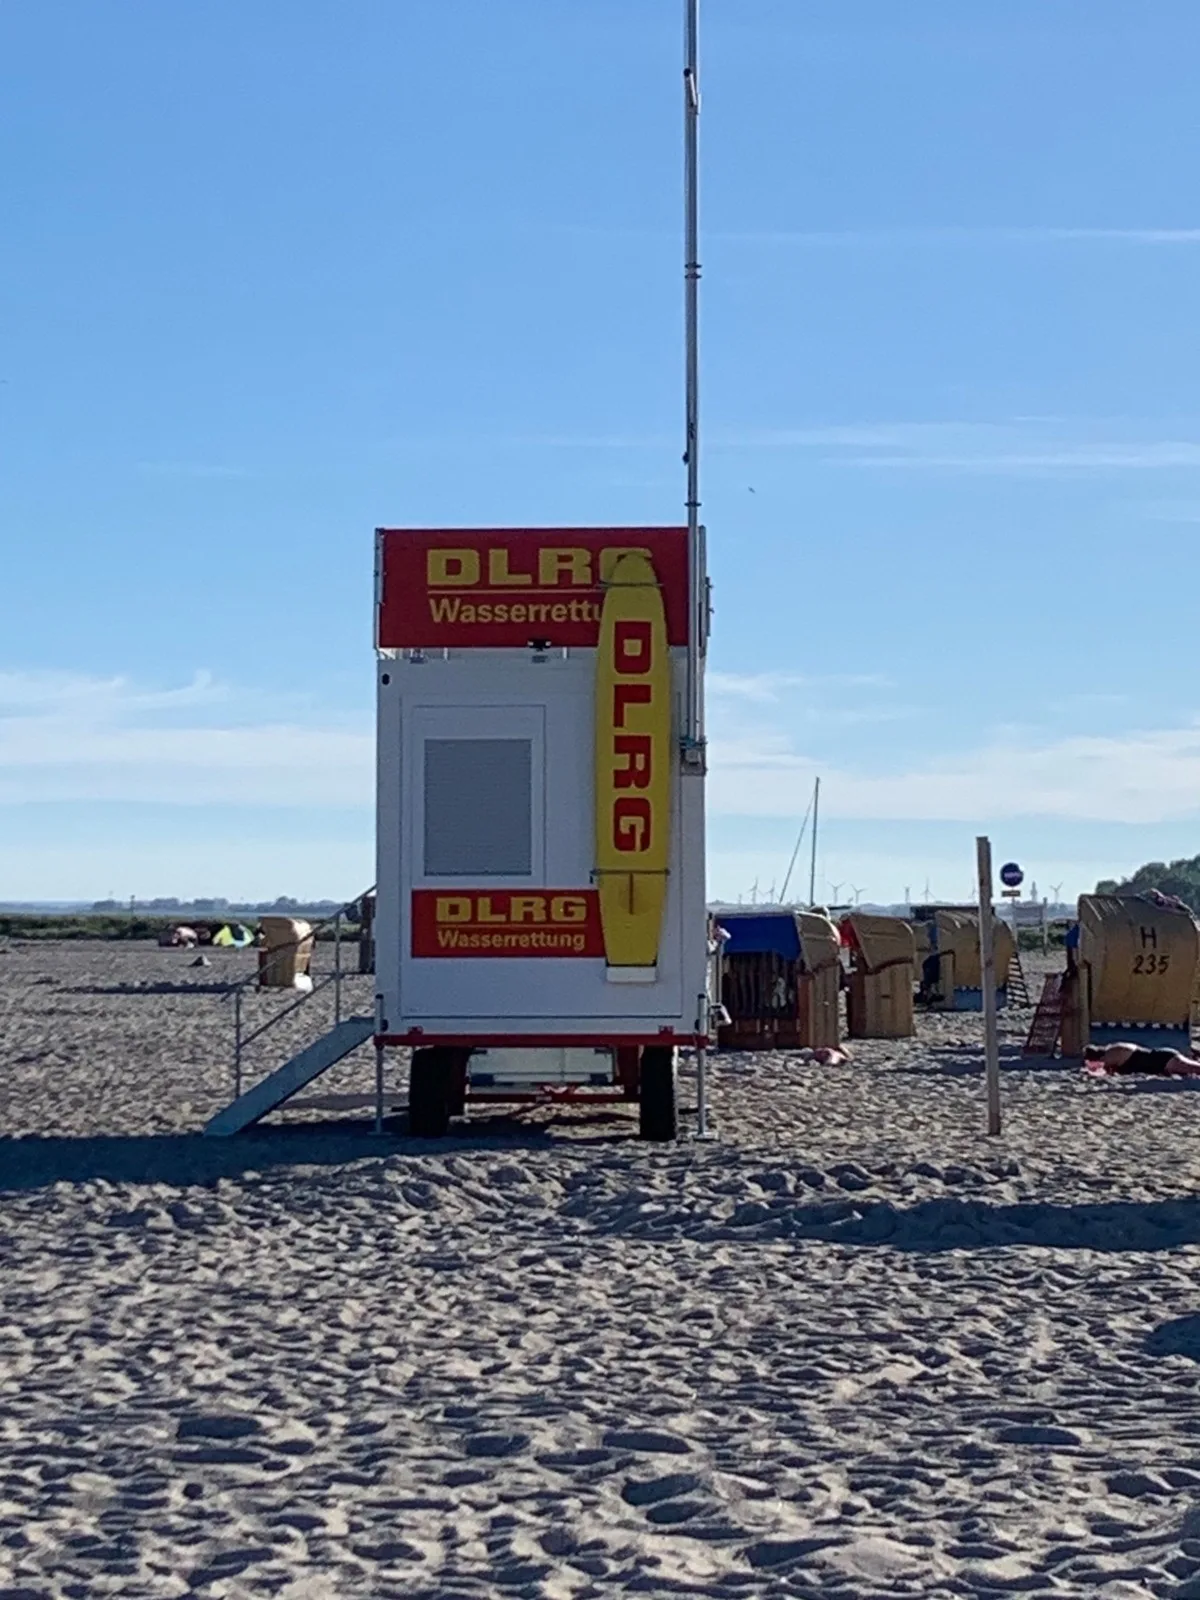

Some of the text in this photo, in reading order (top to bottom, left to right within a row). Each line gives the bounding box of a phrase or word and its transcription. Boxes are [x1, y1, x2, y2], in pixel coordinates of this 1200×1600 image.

[613, 620, 651, 852] DLRG
[436, 896, 587, 922] DLRG
[437, 929, 586, 952] Wasserrettung
[1140, 926, 1157, 949] H
[1133, 953, 1170, 975] 235
